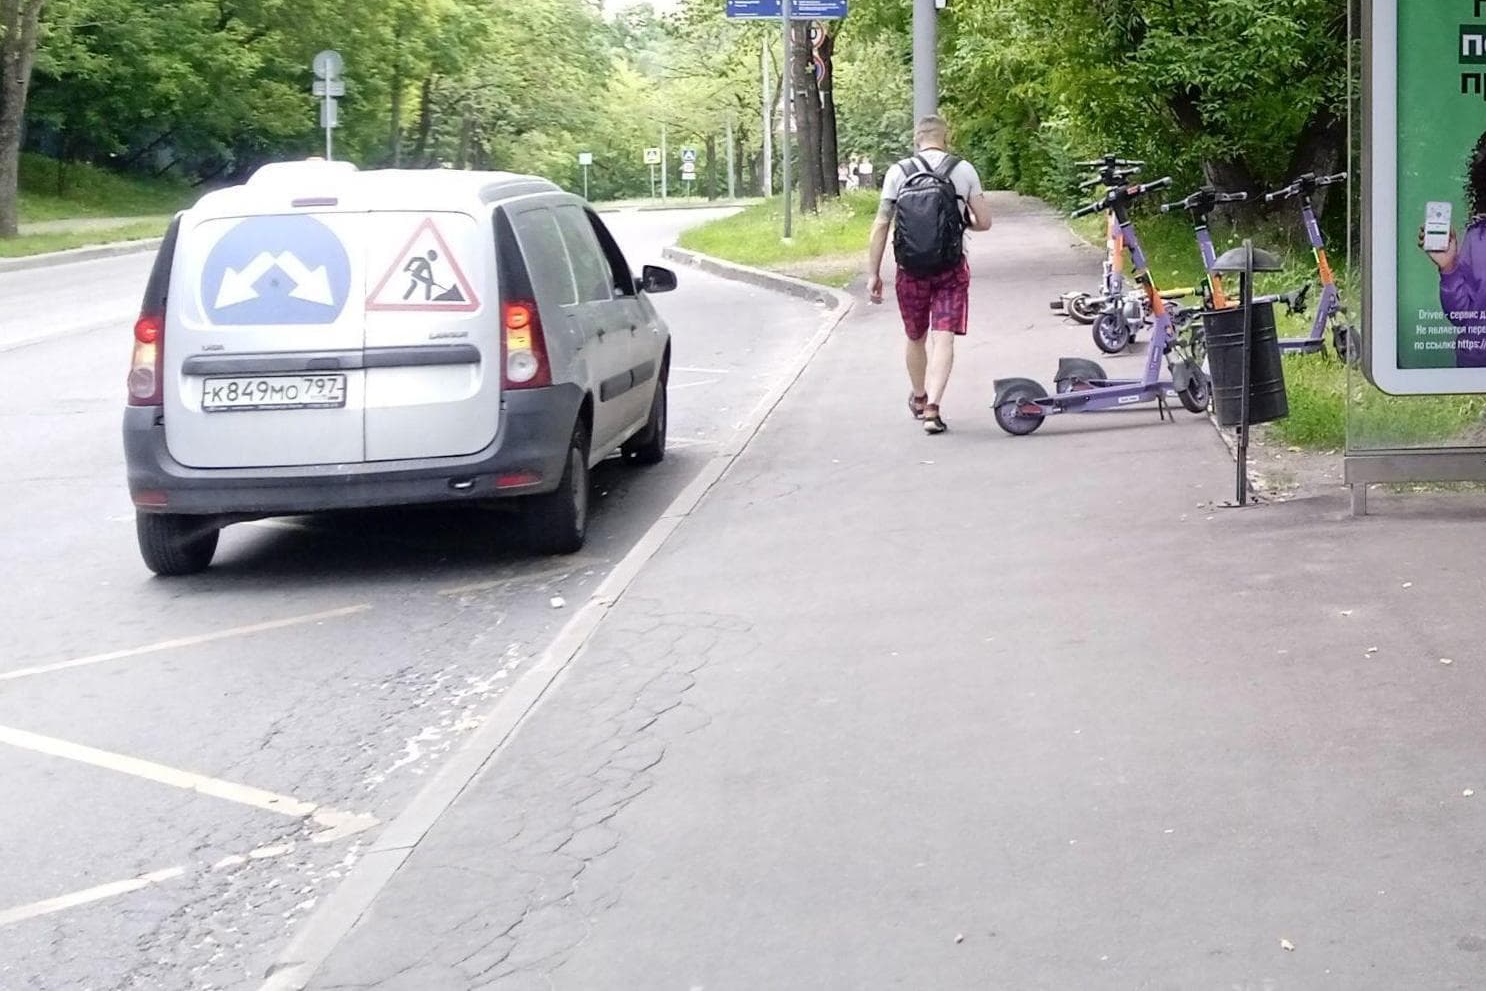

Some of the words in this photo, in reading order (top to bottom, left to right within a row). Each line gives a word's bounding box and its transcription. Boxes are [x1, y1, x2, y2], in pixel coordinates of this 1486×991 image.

[1418, 309, 1444, 320] Drivee
[1450, 311, 1478, 320] сервис
[1416, 325, 1427, 335] Не
[1415, 342, 1425, 350] по
